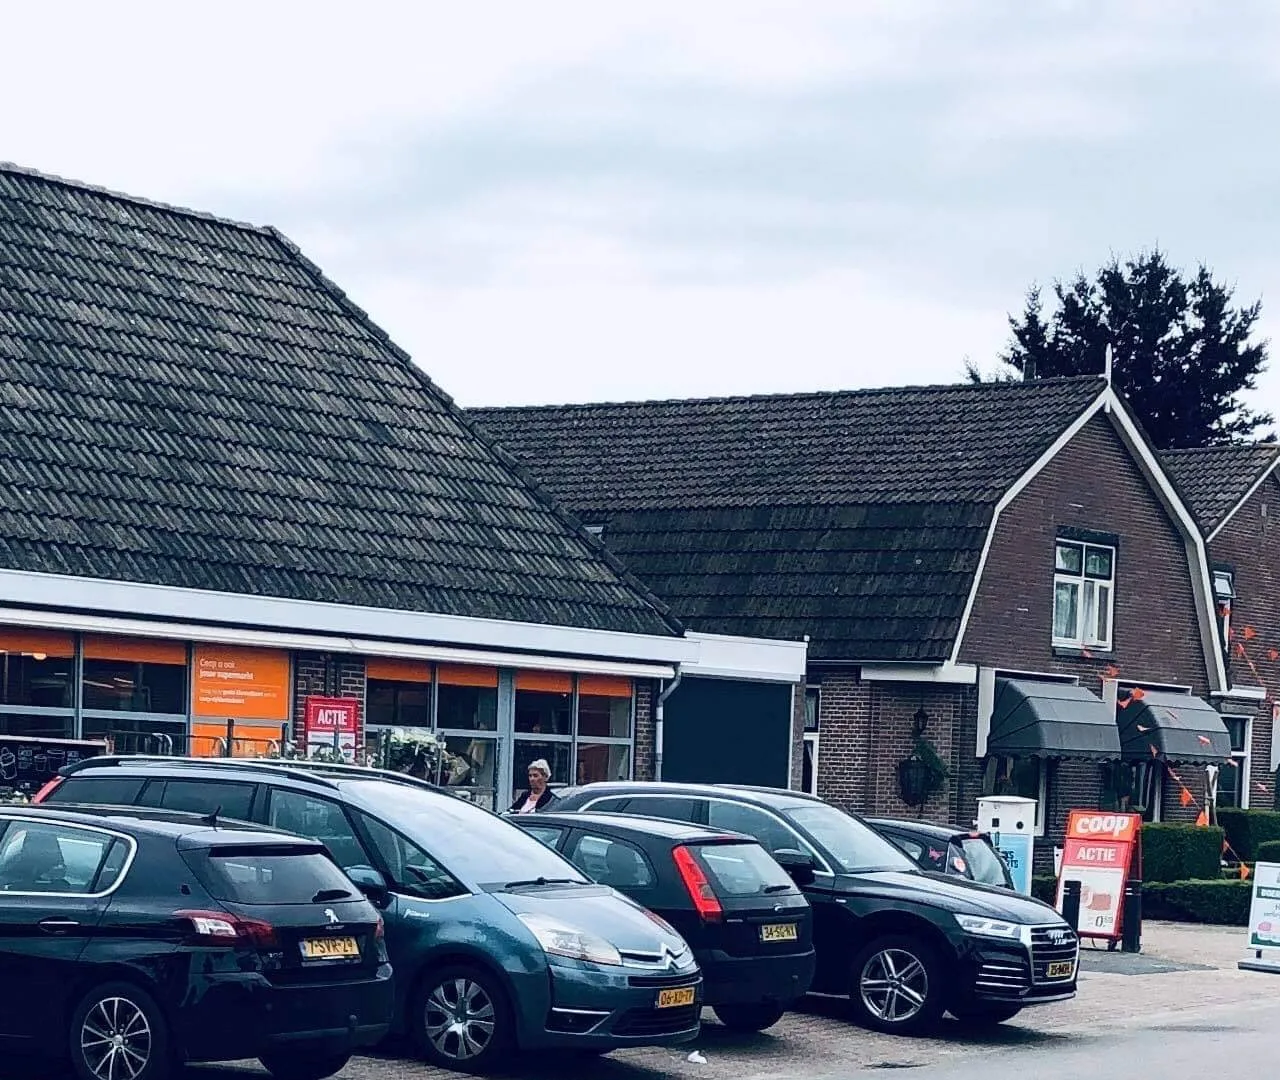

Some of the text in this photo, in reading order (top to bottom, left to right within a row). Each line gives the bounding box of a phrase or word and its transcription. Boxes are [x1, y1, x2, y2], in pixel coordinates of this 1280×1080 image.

[317, 709, 348, 726] ACTIE
[1076, 815, 1130, 837] coop
[1076, 847, 1117, 862] ACTIE
